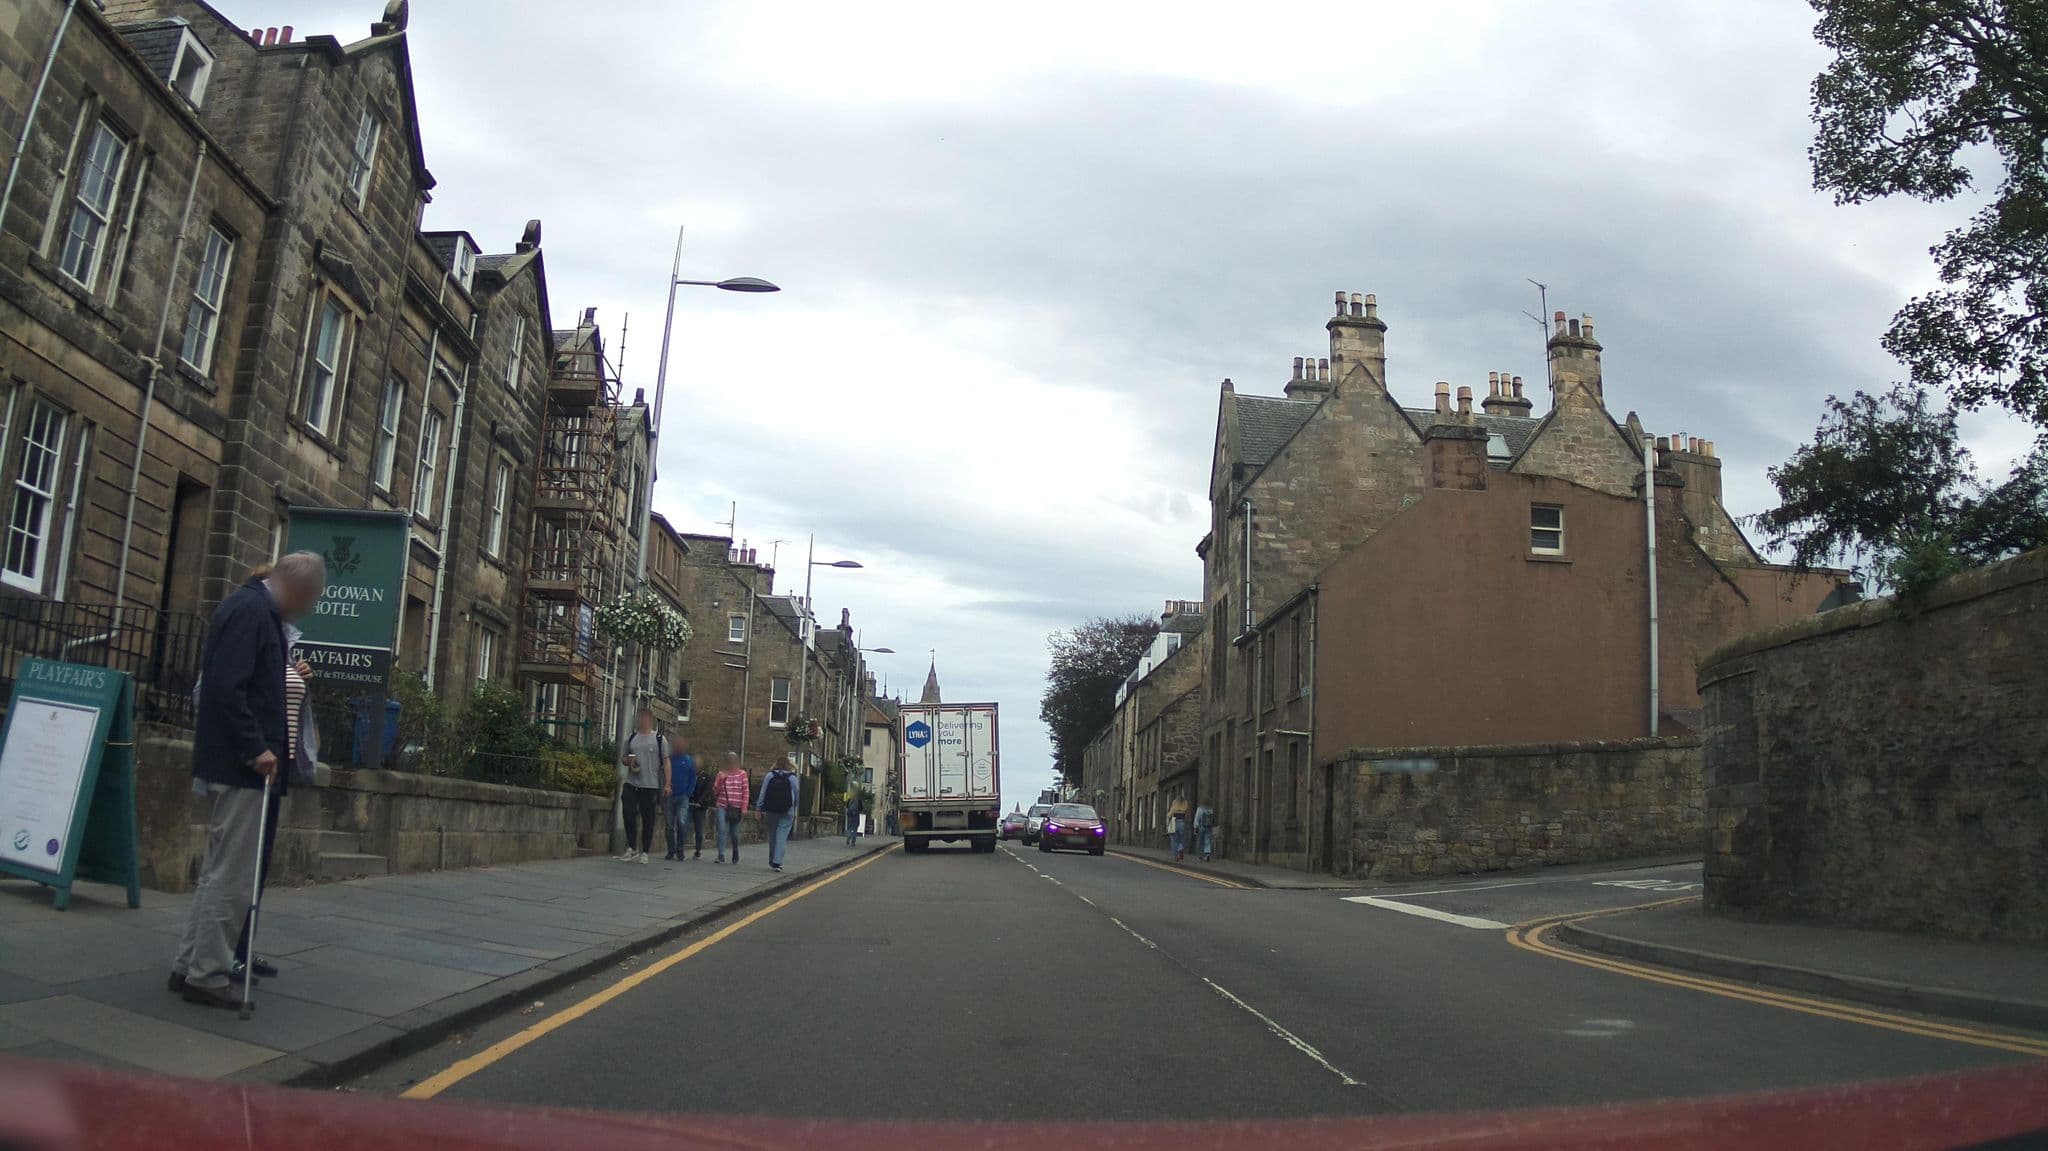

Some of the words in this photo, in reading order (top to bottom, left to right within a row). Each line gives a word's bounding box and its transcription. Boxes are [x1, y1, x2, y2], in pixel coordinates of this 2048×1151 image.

[320, 585, 384, 602] GOWAN
[292, 648, 372, 667] PLAYFAIR'S
[28, 662, 106, 689] PLAYFAIR'S
[332, 671, 382, 683] STEAKHOUSE
